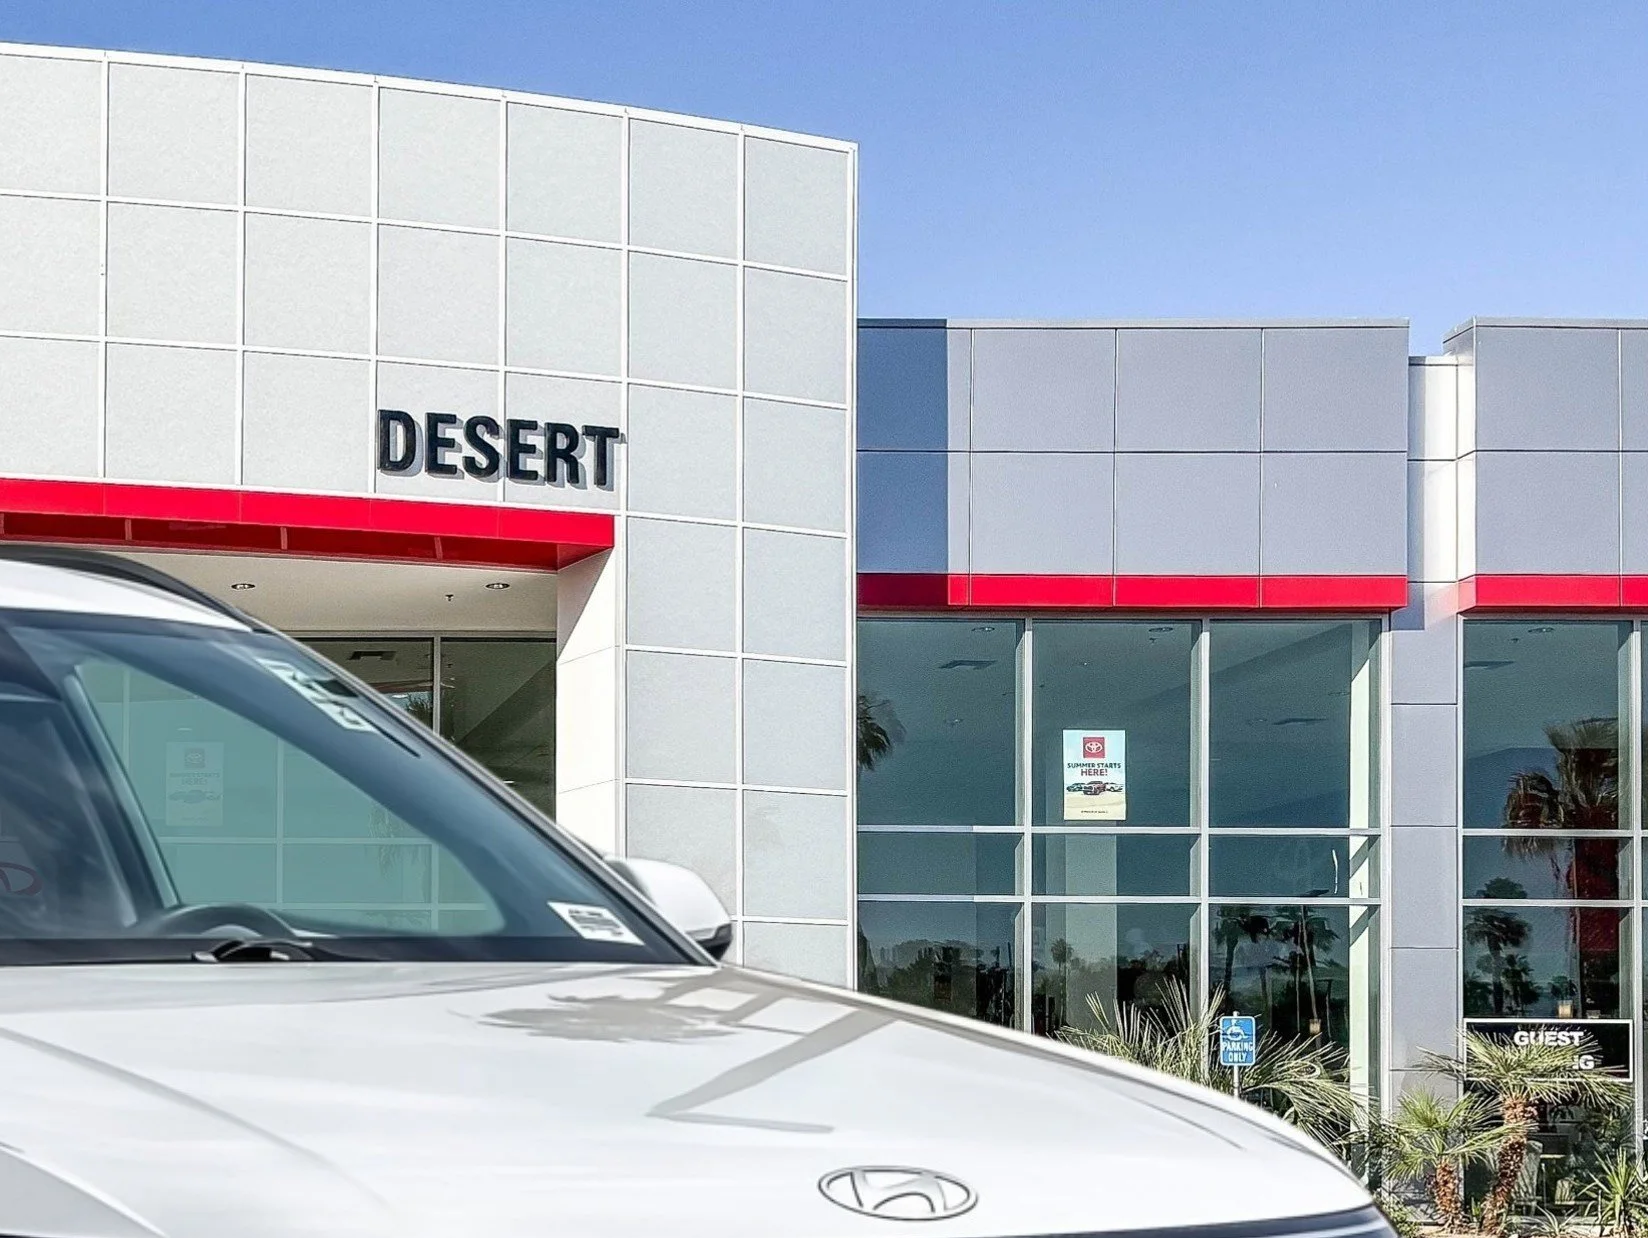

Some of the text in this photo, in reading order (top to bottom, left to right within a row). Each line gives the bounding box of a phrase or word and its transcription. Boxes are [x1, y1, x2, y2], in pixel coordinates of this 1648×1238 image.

[377, 409, 620, 486] DESERT
[1080, 768, 1108, 777] HERE!
[1513, 1030, 1584, 1047] GUEST
[1222, 1041, 1254, 1052] PARKING
[1228, 1052, 1248, 1063] ONLY
